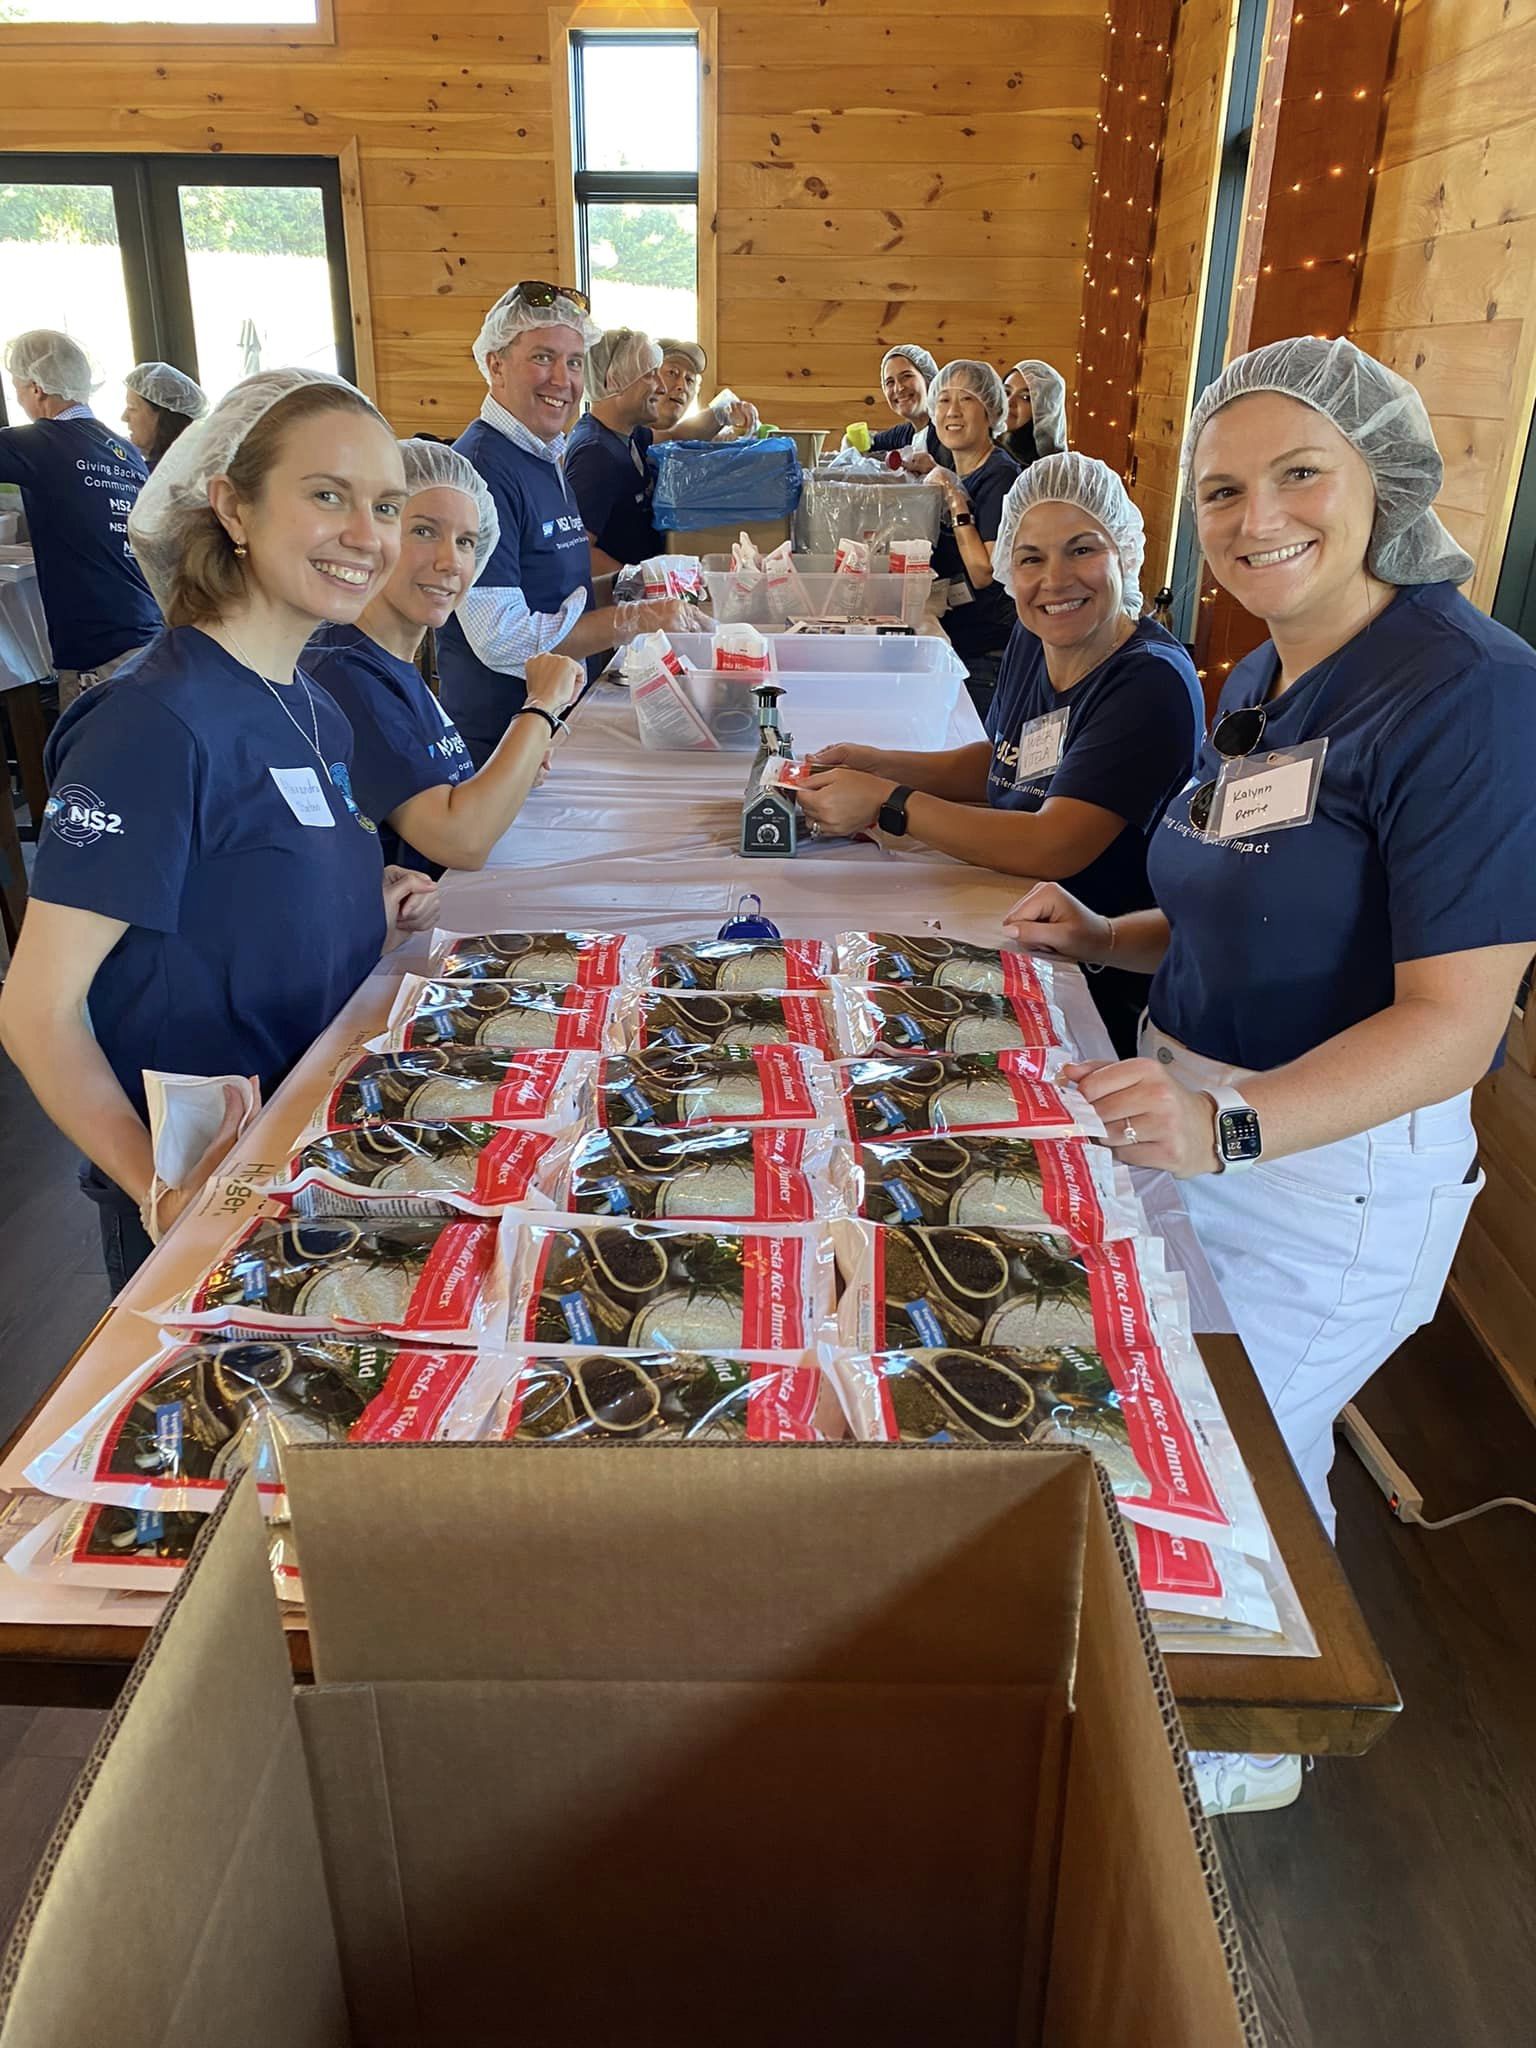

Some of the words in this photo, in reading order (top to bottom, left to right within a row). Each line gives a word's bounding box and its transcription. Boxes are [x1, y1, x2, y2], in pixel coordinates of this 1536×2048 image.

[76, 459, 112, 476] Giving
[113, 465, 137, 479] Back
[1232, 784, 1272, 803] Kalynn
[1231, 838, 1270, 854] Impact
[438, 1265, 466, 1309] Dinner
[1111, 1269, 1130, 1303] Rice
[771, 1302, 787, 1350] Dinner
[1119, 1304, 1137, 1347] Dinn
[407, 1354, 449, 1400] Fiesta
[1147, 1395, 1170, 1432] Rice
[1159, 1433, 1190, 1496] Dinner
